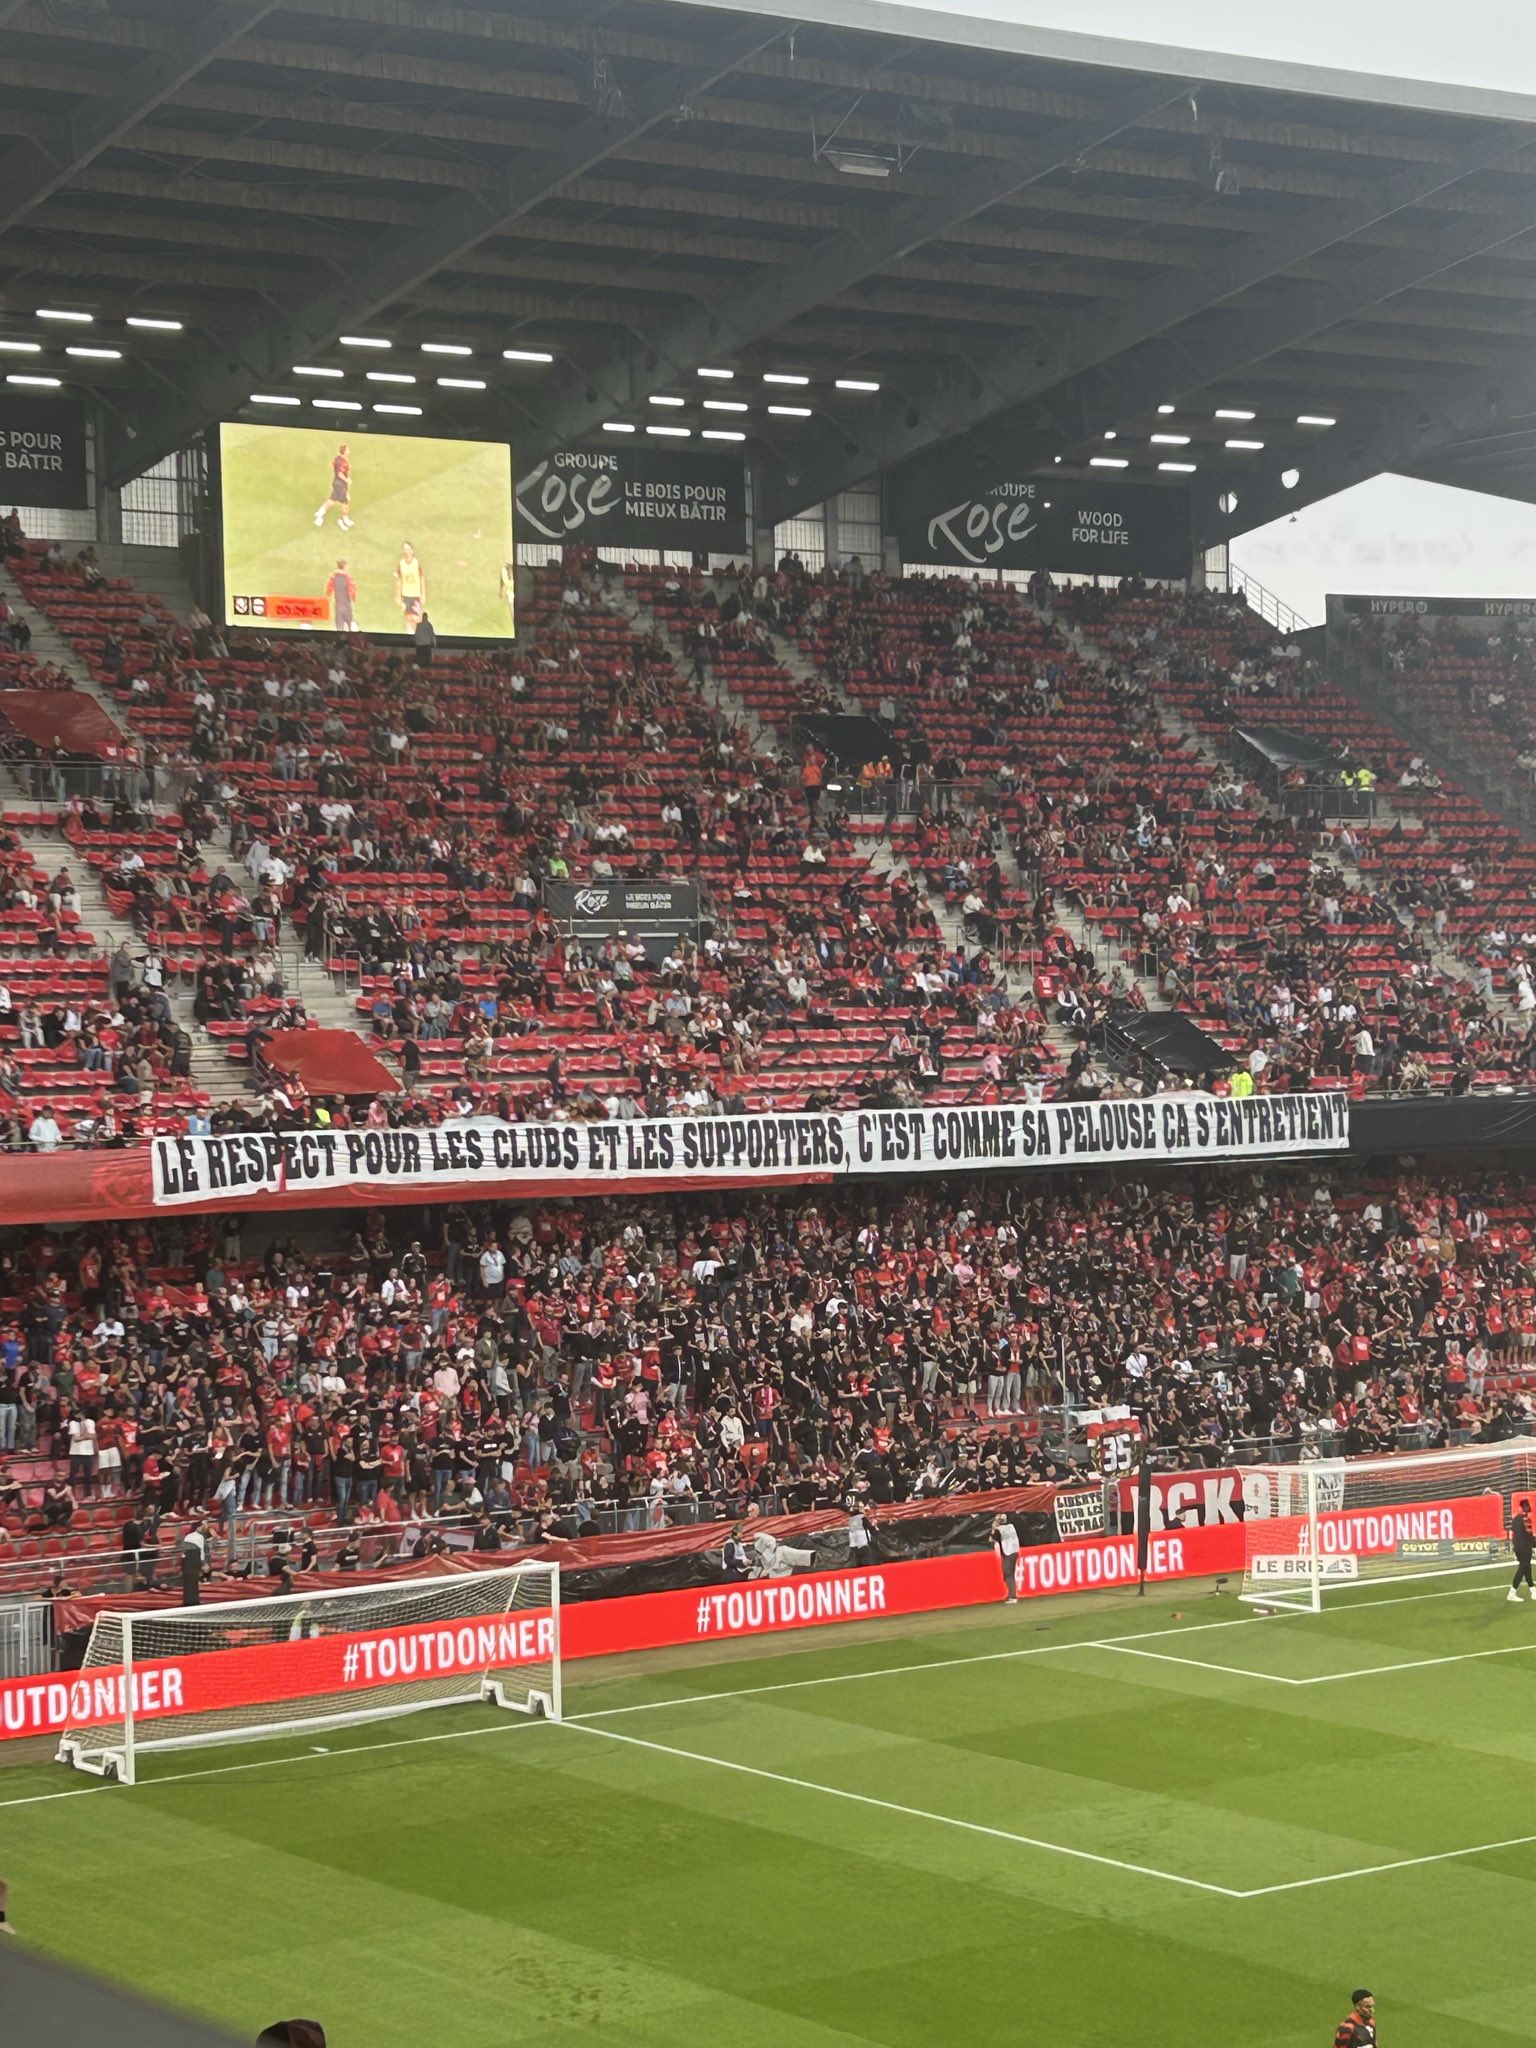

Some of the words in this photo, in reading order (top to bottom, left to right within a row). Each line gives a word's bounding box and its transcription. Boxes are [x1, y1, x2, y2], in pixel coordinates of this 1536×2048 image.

[10, 431, 62, 450] POUR
[554, 453, 618, 470] GROUPE
[625, 481, 641, 497] LE
[646, 483, 681, 500] BOIS
[685, 485, 726, 503] POUR
[985, 483, 1035, 498] OUPE
[625, 501, 677, 519] MIEUX
[1078, 510, 1122, 527] WOOD
[1073, 528, 1098, 543] FOR
[1101, 530, 1129, 545] LIFE
[157, 1139, 199, 1194] LE
[203, 1134, 338, 1188] RESPECT
[345, 1132, 421, 1174] POUR
[428, 1129, 482, 1171] LES
[494, 1127, 579, 1169] CLUBS
[588, 1126, 621, 1170] ET
[625, 1123, 674, 1168] LES
[682, 1117, 850, 1173] SUPPORTERS,
[858, 1112, 925, 1162] C'EST
[932, 1110, 1015, 1159] COMME
[1023, 1109, 1050, 1156] SA
[1056, 1104, 1156, 1154] PELOUSE
[1195, 1093, 1348, 1147] S'ENTRETIENT
[1103, 1434, 1131, 1472] 35
[1058, 1508, 1084, 1520] POUR
[1059, 1516, 1104, 1534] ULTRAS
[1015, 1538, 1183, 1590] #TOUTDONER
[1257, 1559, 1278, 1573] LE
[697, 1574, 886, 1633] #TOUTDONNER
[343, 1617, 554, 1682] #TOUTDONNER
[0, 1667, 184, 1730] UTDONNER
